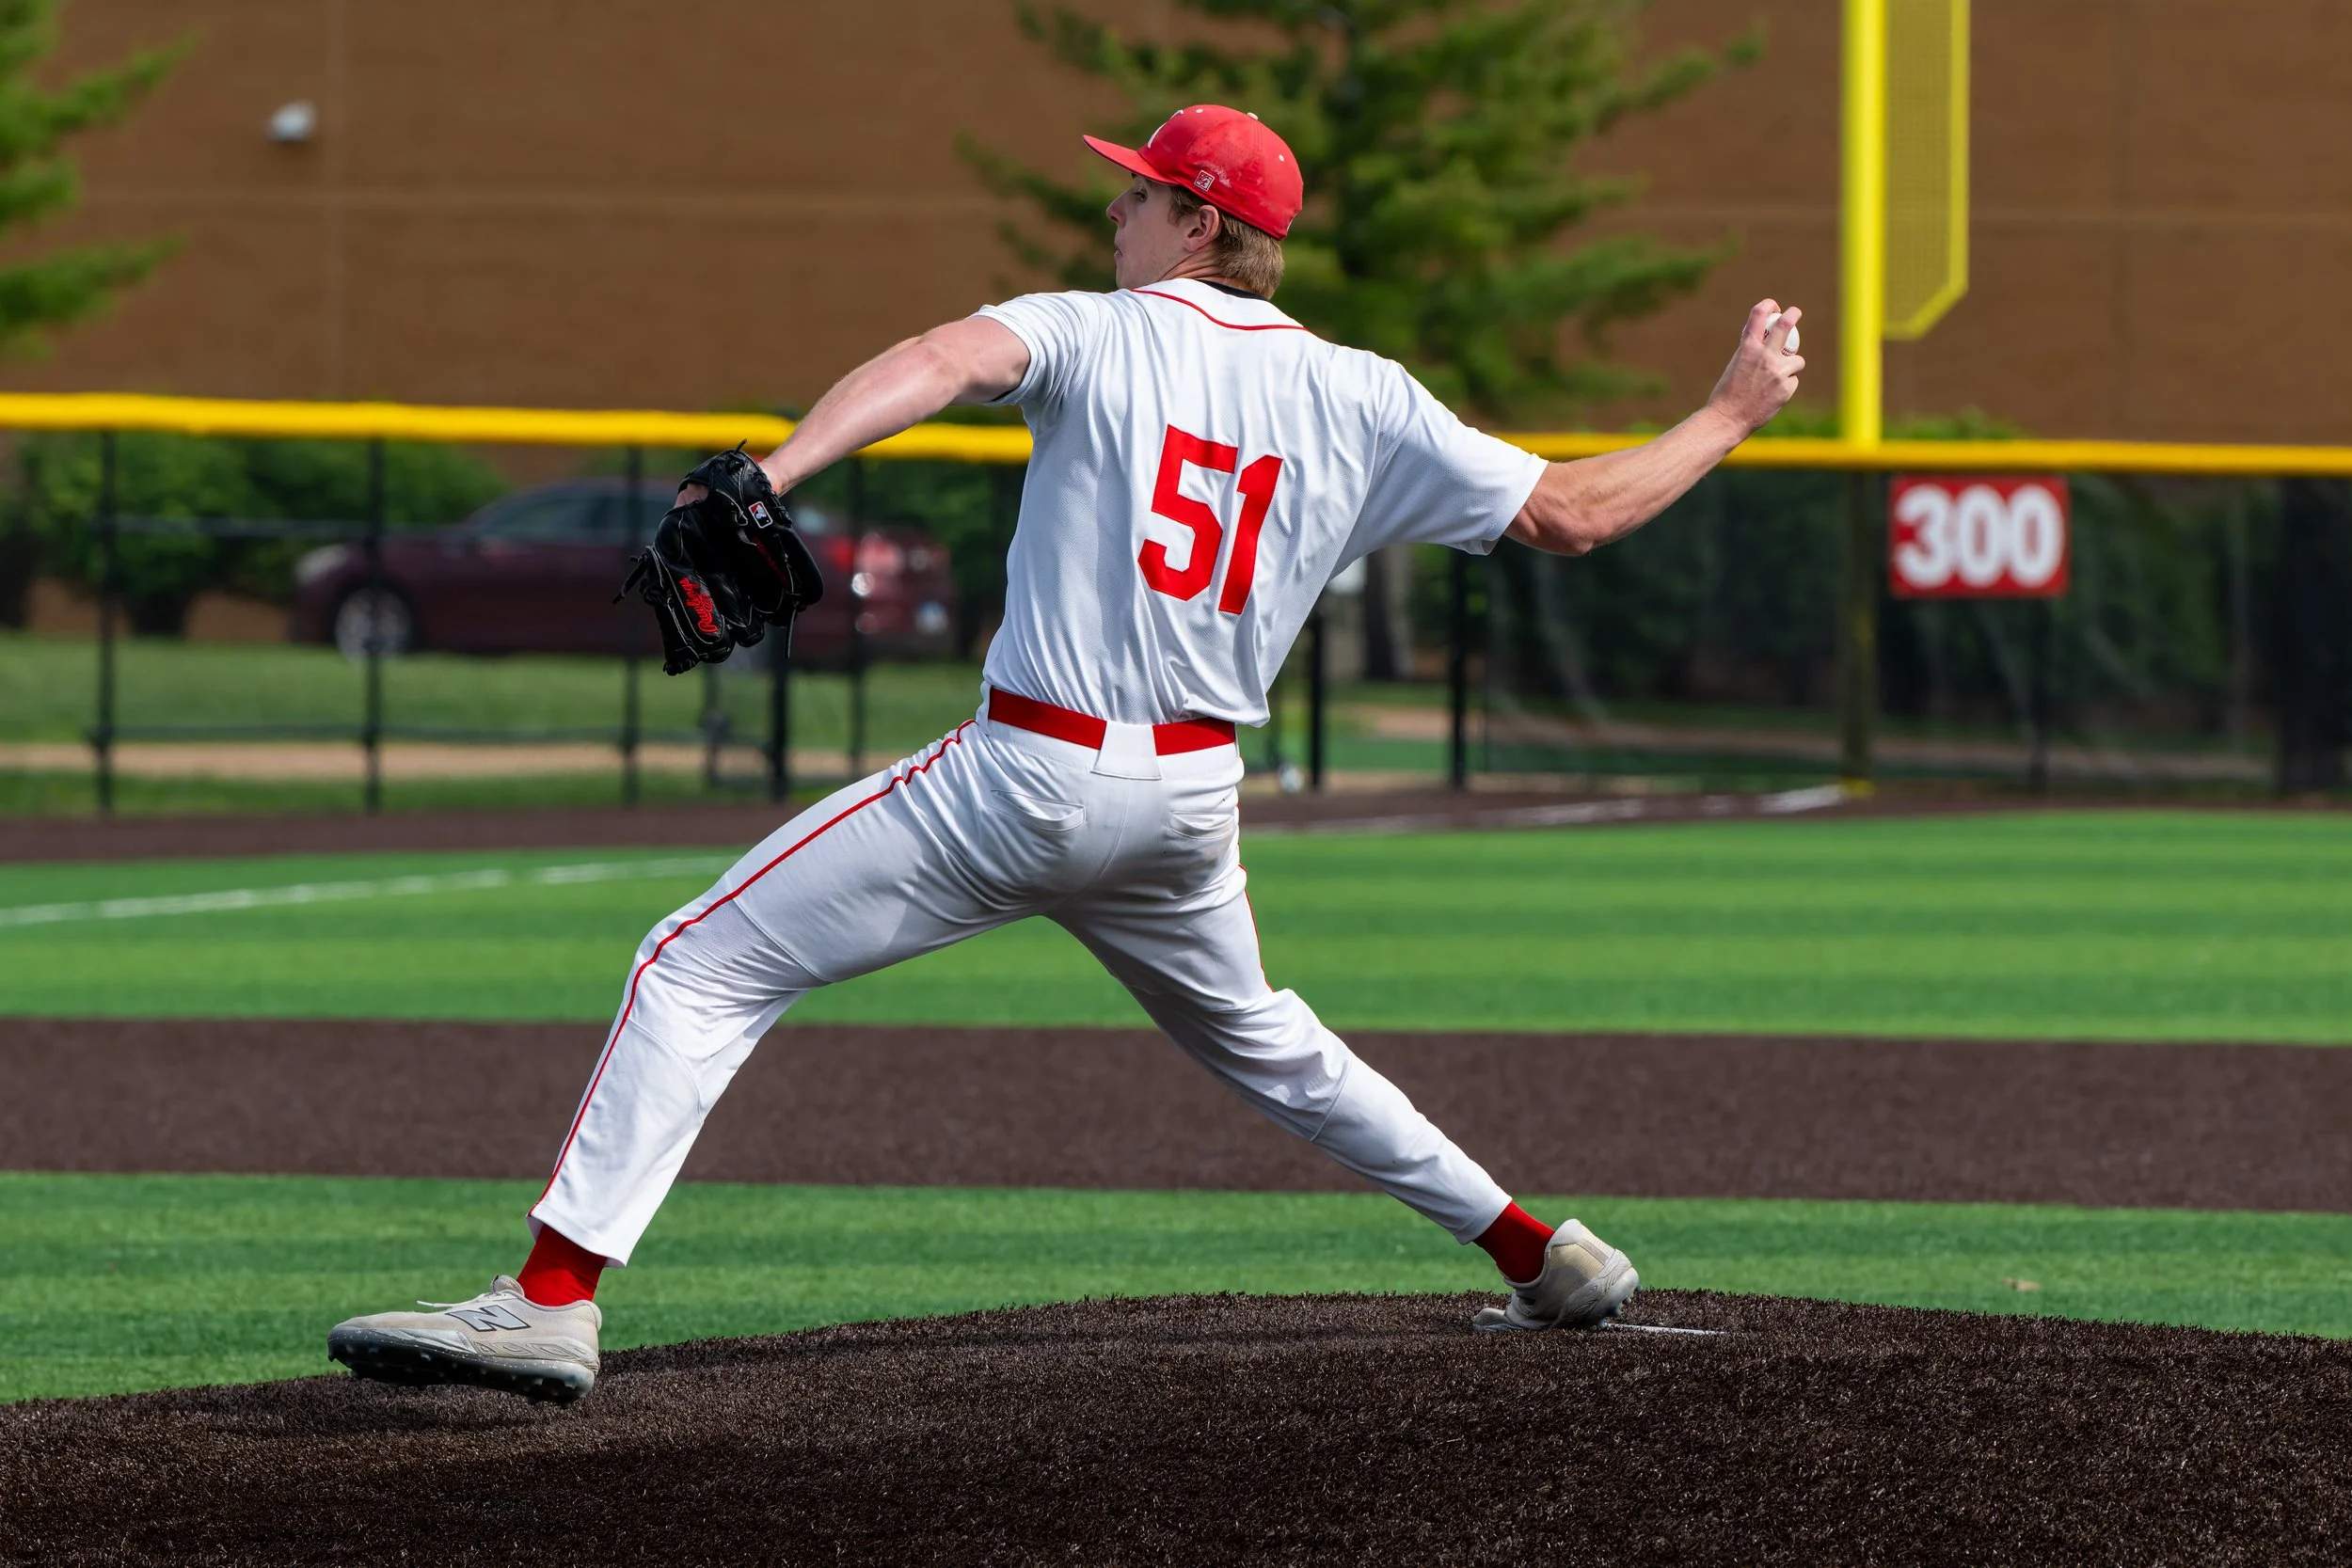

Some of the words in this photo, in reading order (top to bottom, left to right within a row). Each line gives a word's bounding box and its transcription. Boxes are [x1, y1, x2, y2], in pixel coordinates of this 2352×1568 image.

[1137, 423, 1283, 615] 51
[1895, 483, 2065, 590] 300
[678, 578, 718, 633] Rawlings
